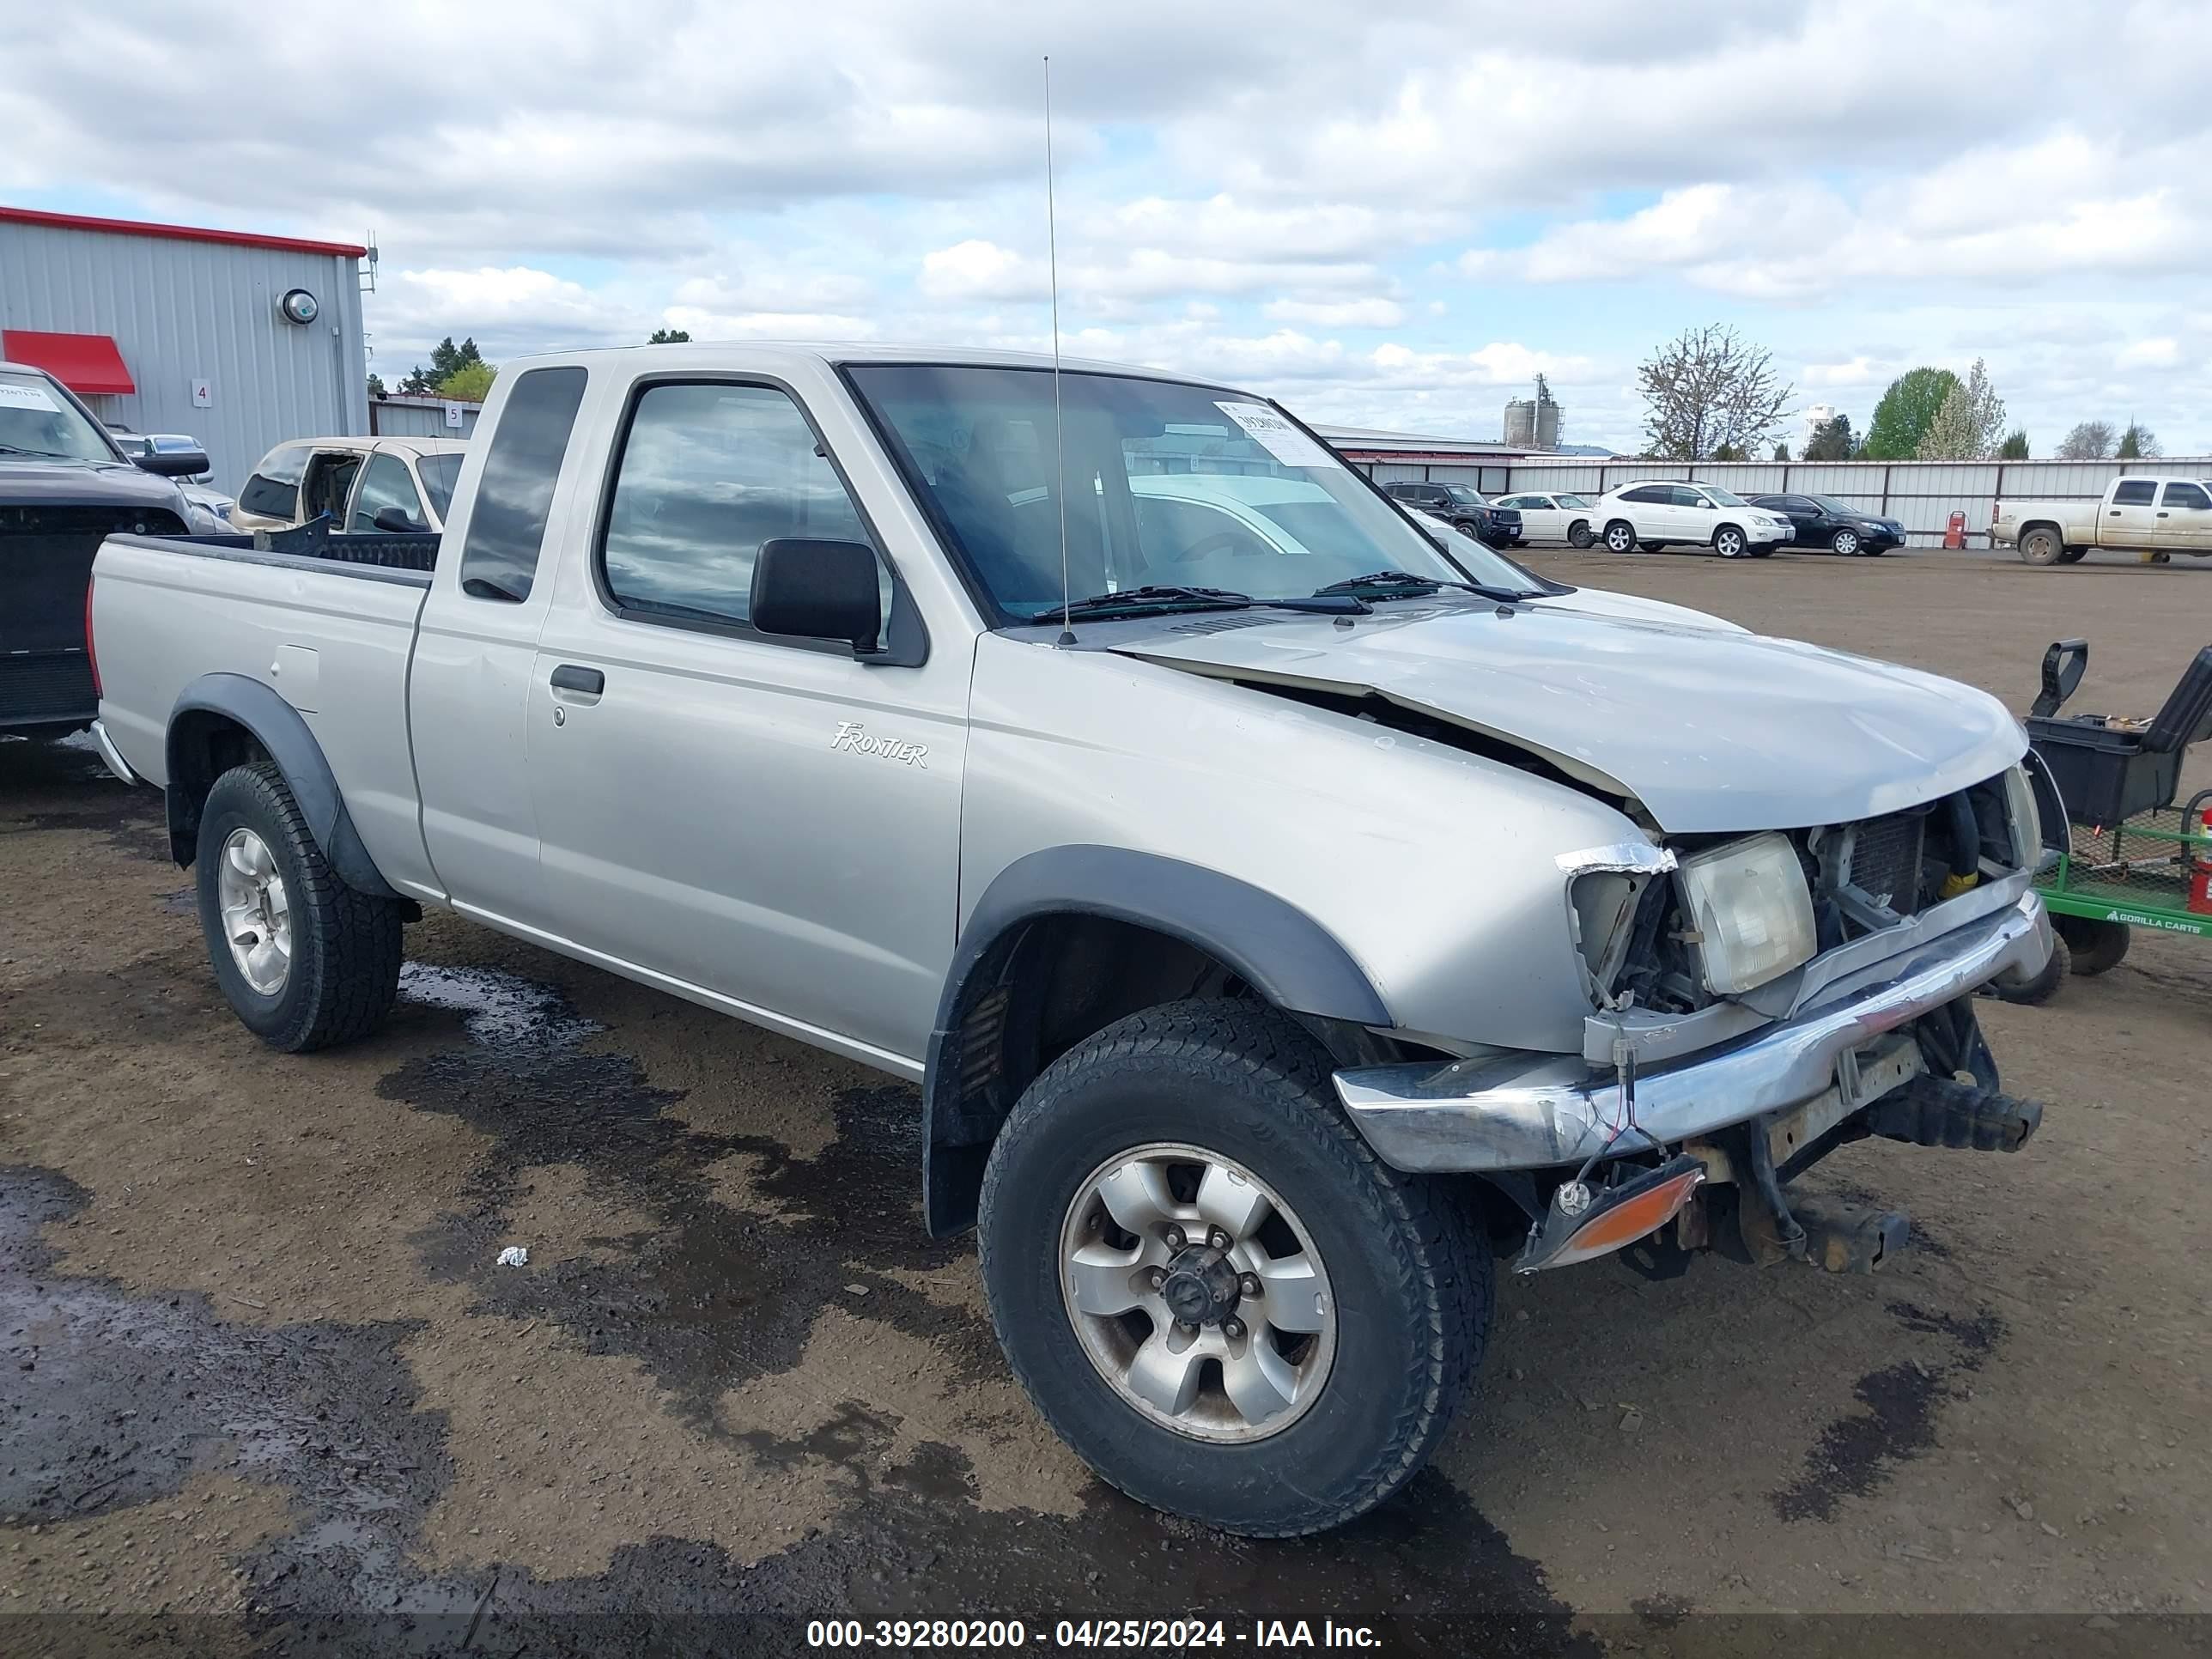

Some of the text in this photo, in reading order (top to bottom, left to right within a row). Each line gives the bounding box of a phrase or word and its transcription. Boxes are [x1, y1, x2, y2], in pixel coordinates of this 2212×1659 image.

[198, 386, 206, 399] 4
[451, 408, 458, 420] 5
[2119, 913, 2201, 934] GORILLA CARTS
